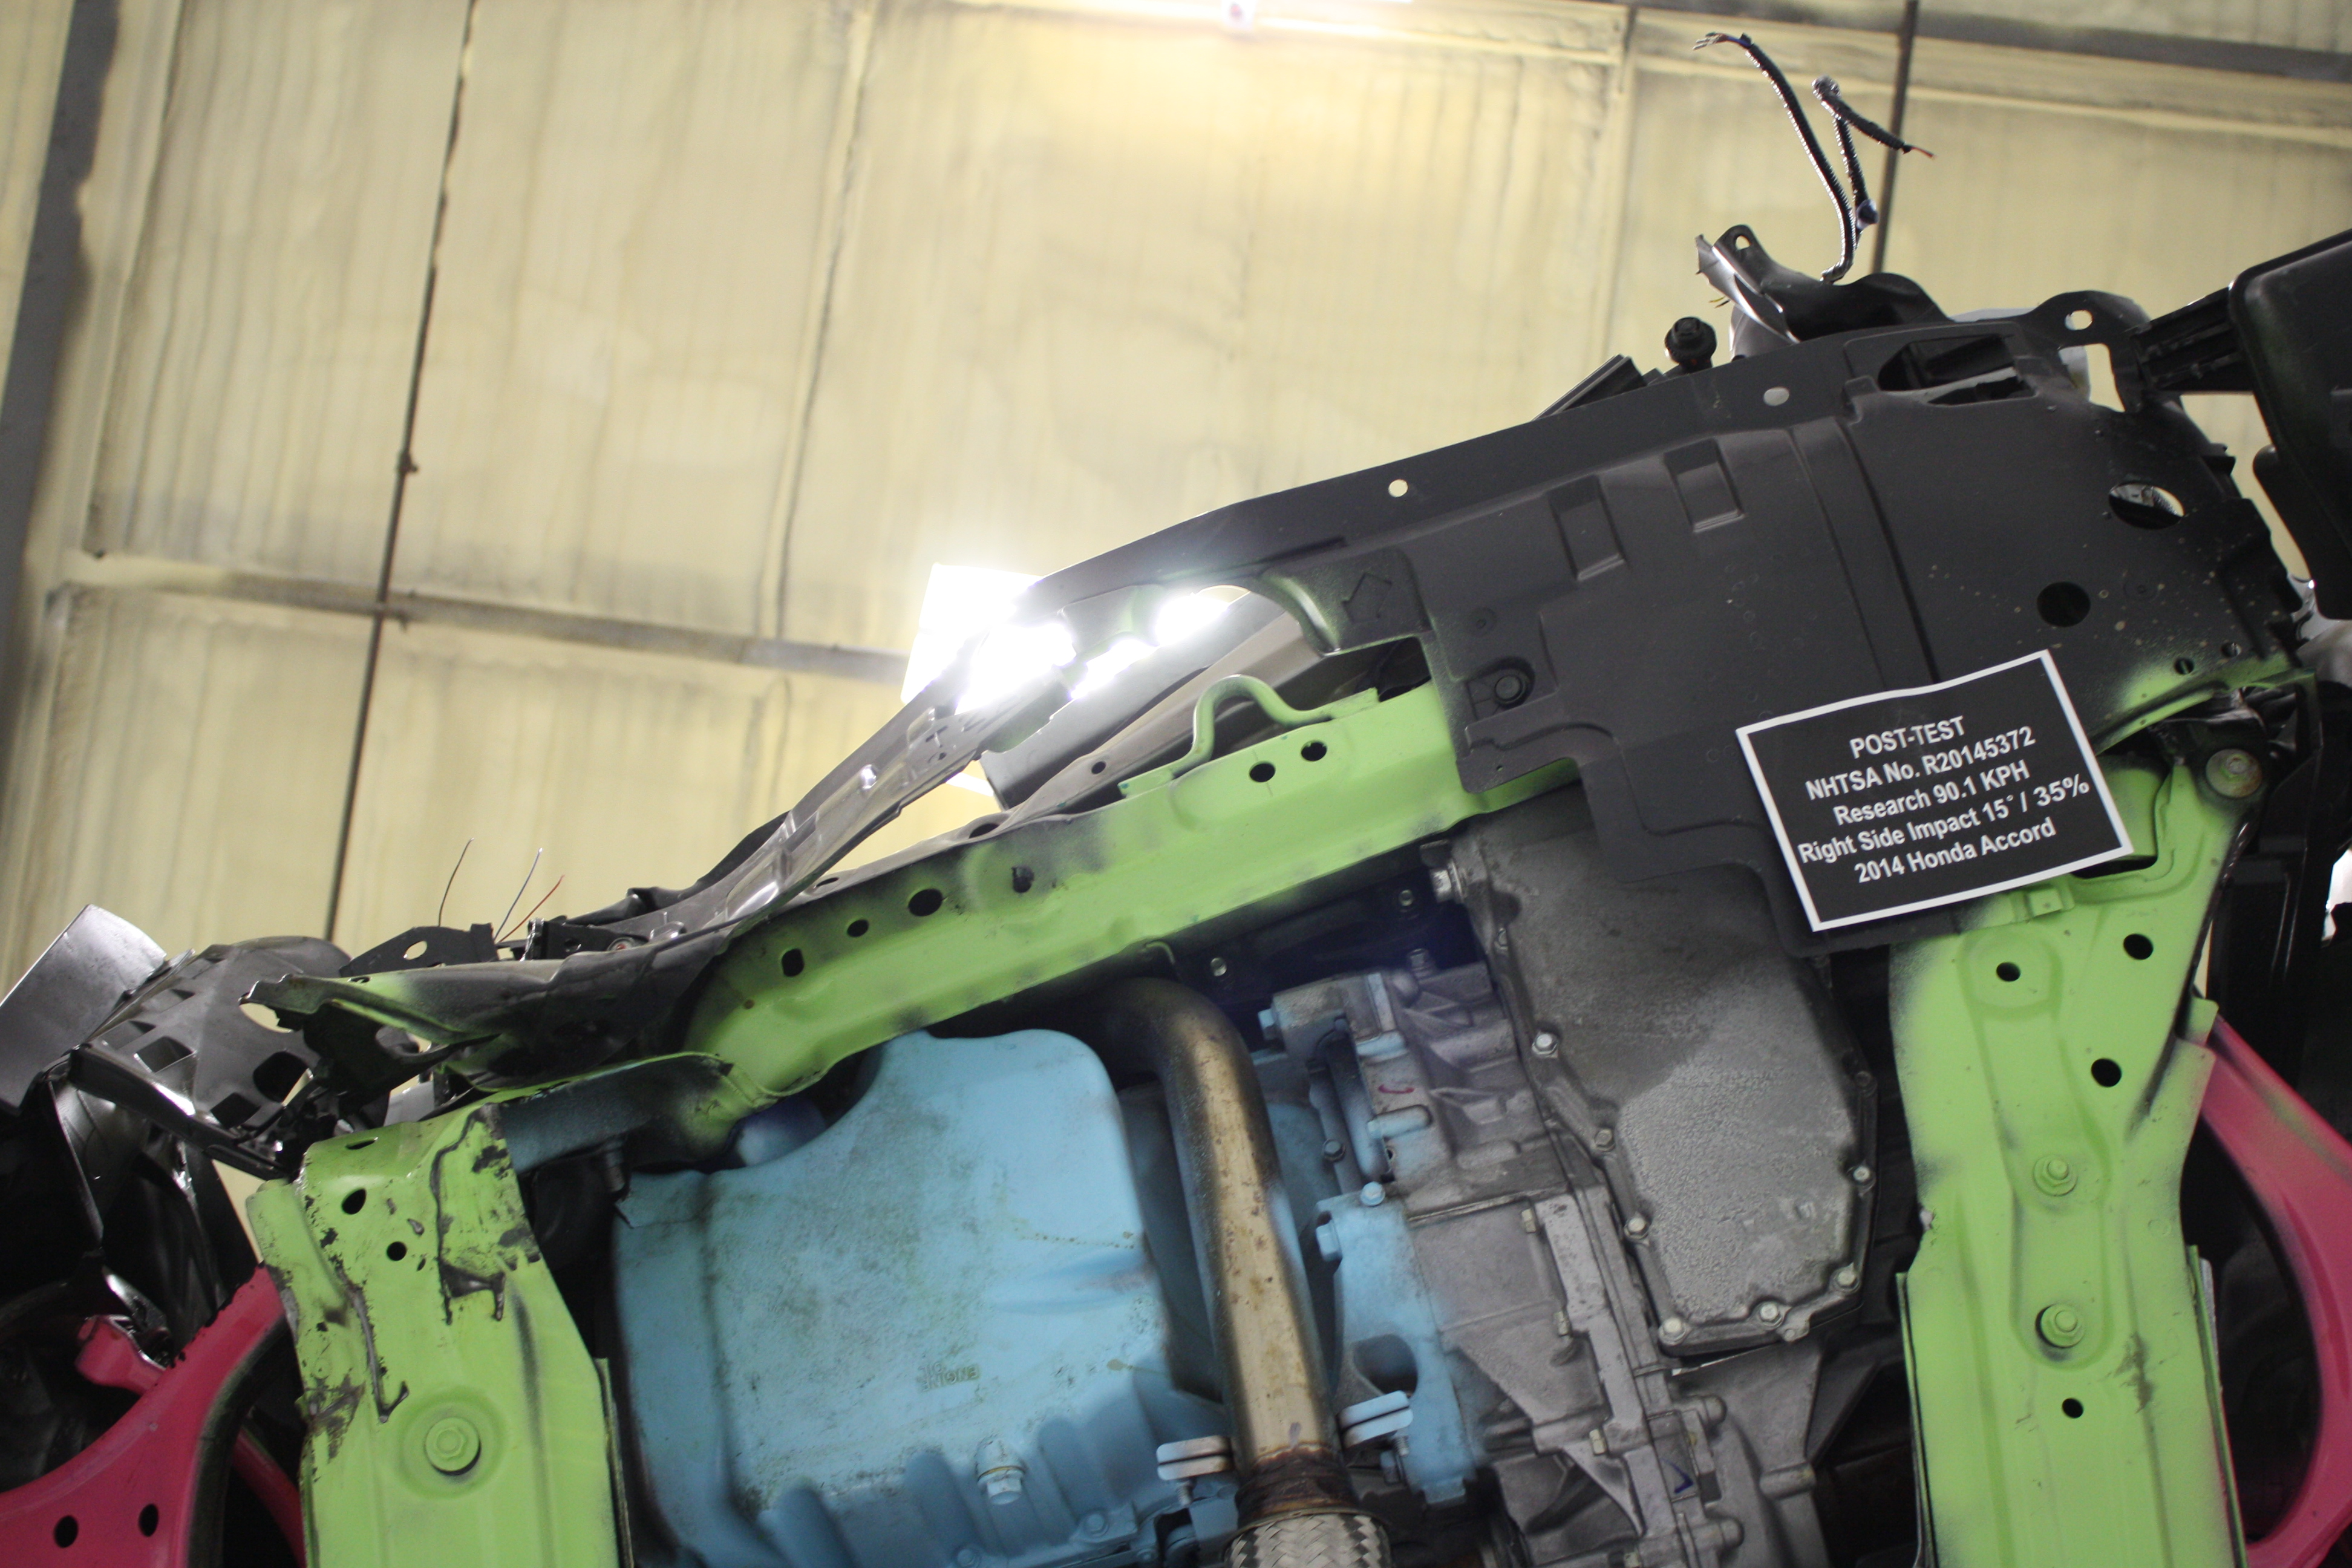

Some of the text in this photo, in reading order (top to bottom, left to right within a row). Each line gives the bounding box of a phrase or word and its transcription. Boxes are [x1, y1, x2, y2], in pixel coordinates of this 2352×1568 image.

[1805, 726, 2036, 800] NHTSA No. R20145372
[1849, 716, 1964, 759] POST-TEST
[1797, 835, 1857, 864] Right
[1858, 825, 1906, 851] Side
[1907, 808, 1981, 841] Impact
[2020, 791, 2028, 812] /
[2033, 773, 2090, 806] 35%
[1833, 760, 2030, 826] Research 90.1 KPH
[1854, 816, 2056, 883] 2014 Honda Accord
[920, 1364, 980, 1392] ENGINE
